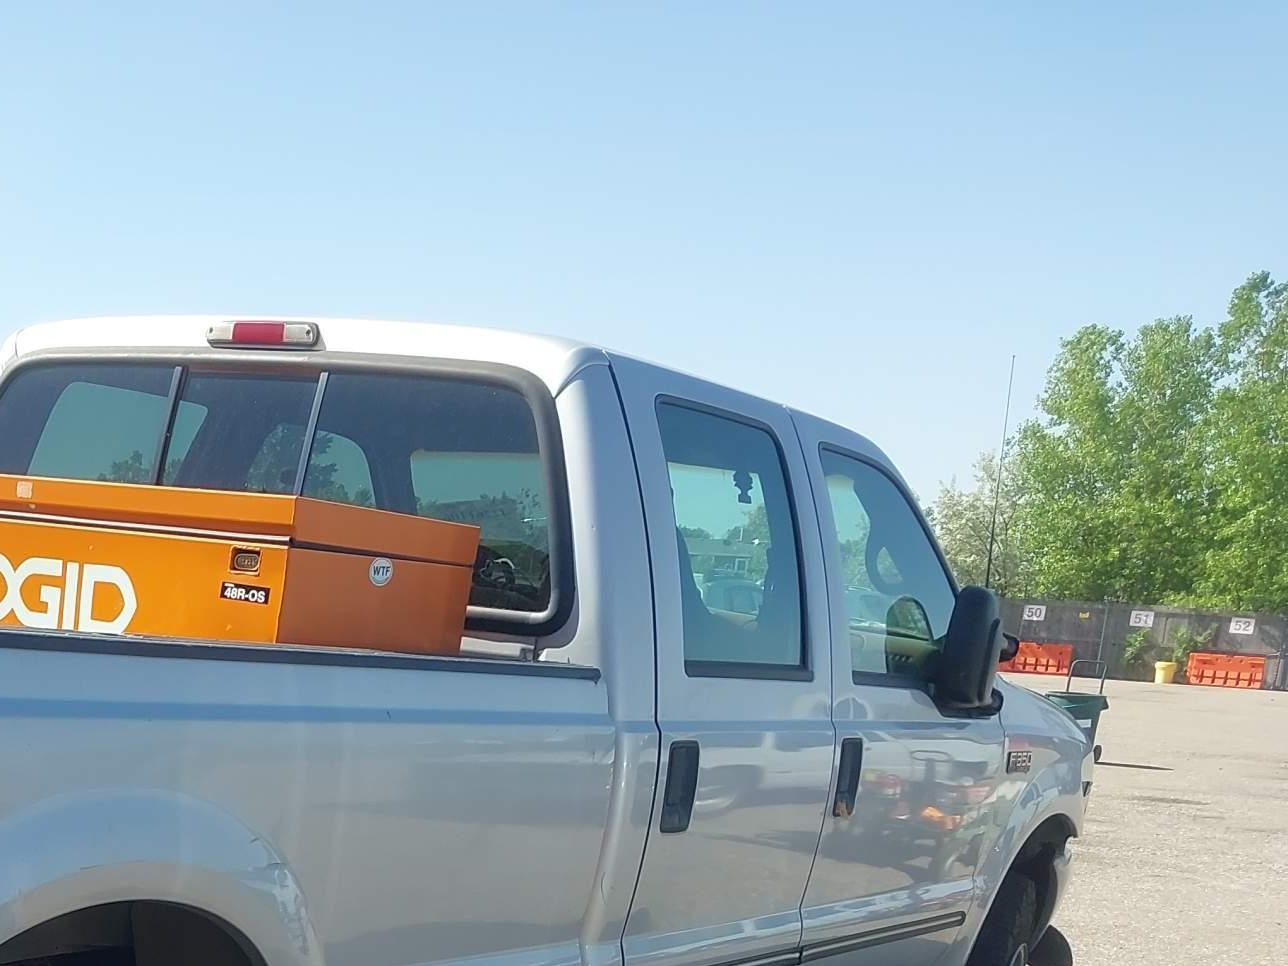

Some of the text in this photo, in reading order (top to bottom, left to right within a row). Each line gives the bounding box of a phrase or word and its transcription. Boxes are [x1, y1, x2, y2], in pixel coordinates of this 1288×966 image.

[373, 565, 392, 577] WTF
[223, 586, 266, 603] 48R-OS
[1026, 607, 1042, 618] 50
[1133, 613, 1150, 625] 51
[1233, 620, 1252, 632] 52
